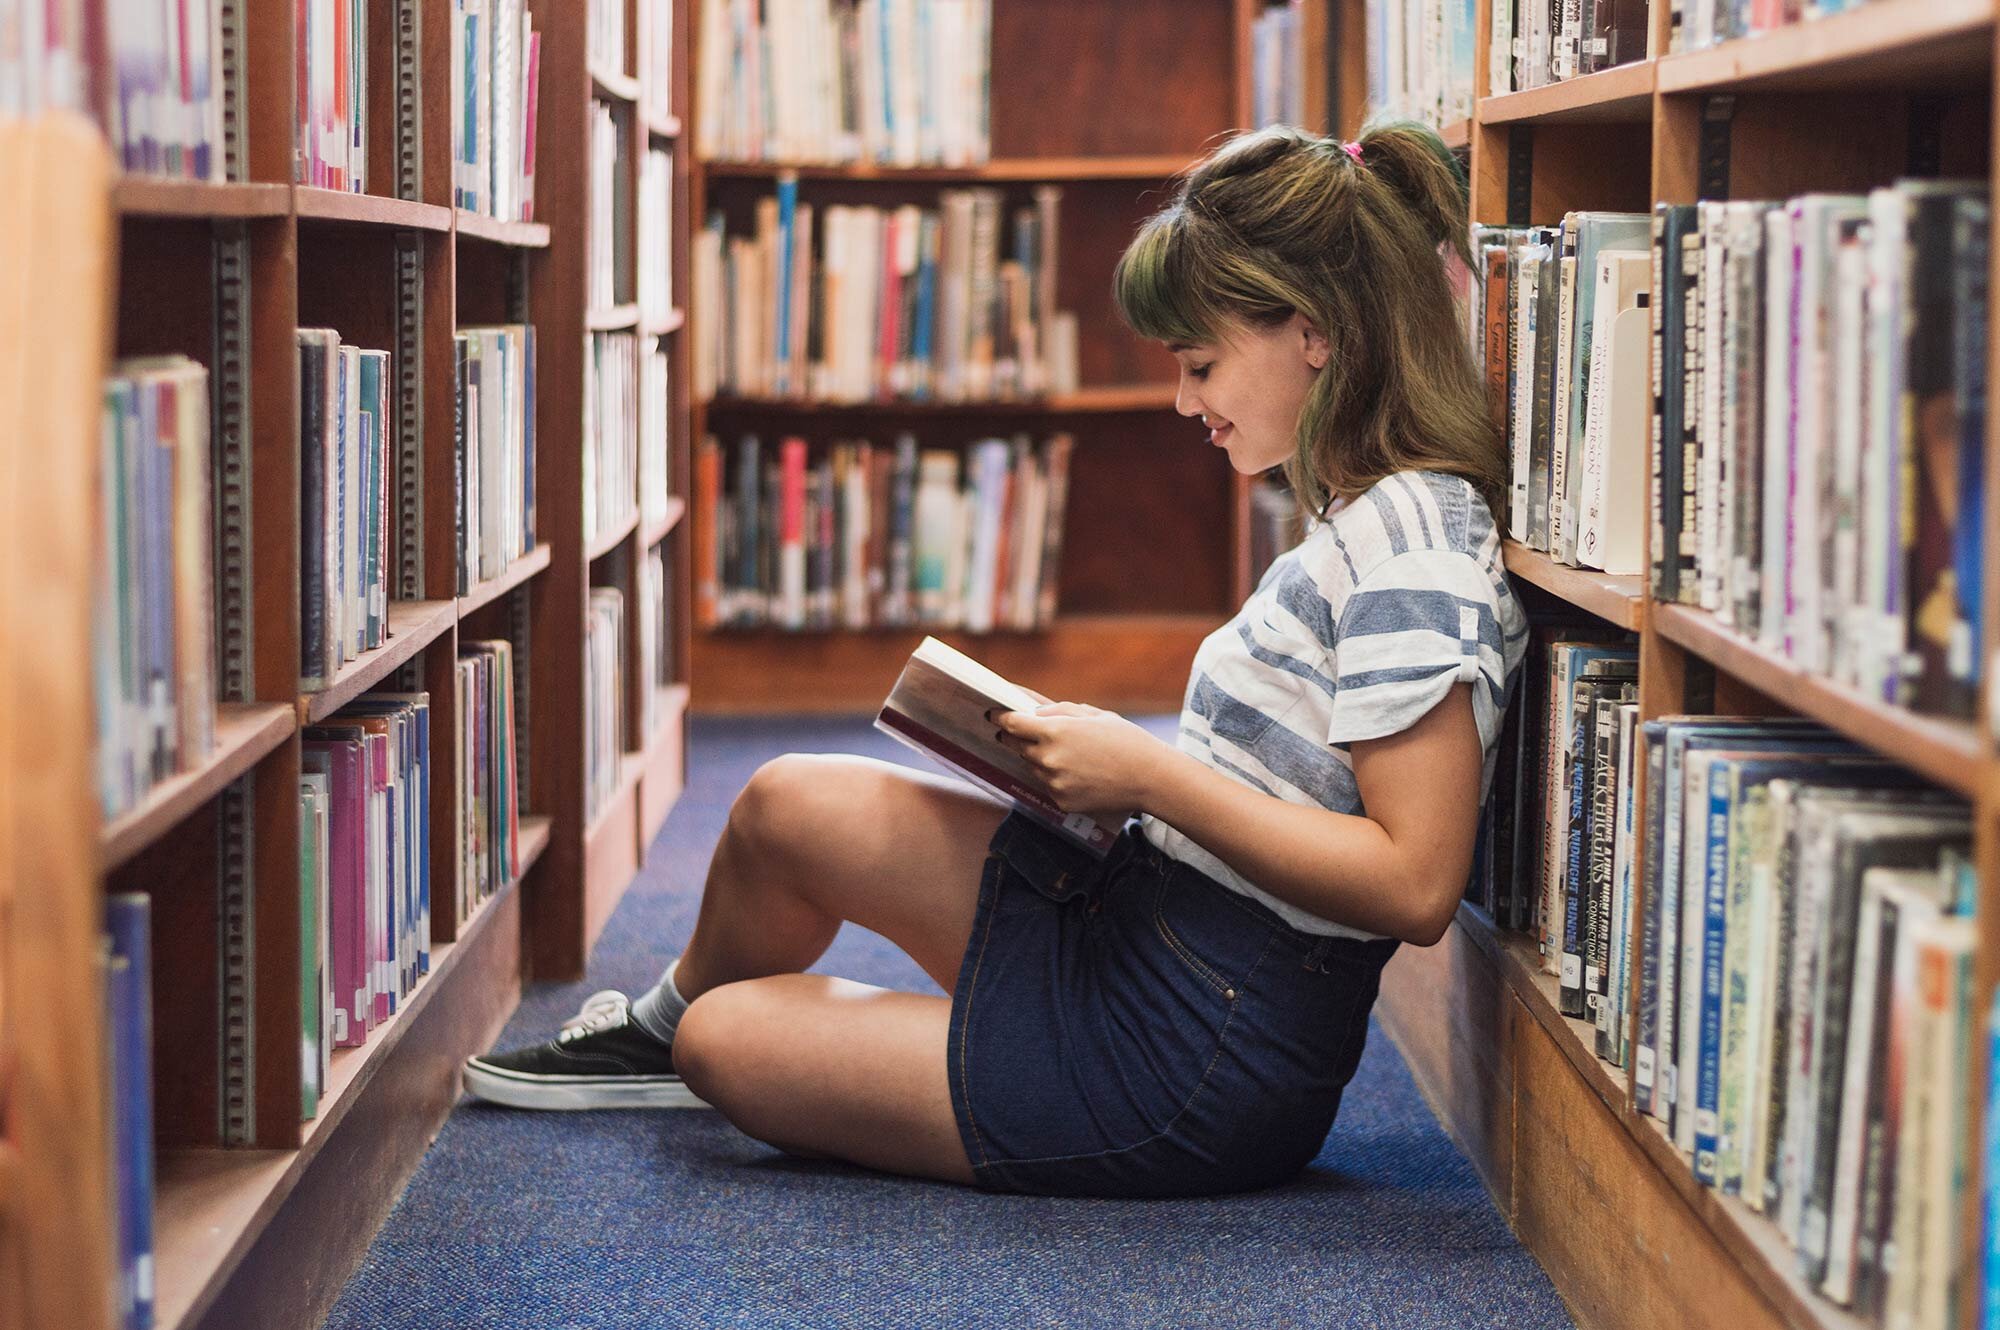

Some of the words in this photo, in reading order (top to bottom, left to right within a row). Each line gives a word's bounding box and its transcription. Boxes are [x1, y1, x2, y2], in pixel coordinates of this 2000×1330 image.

[1560, 293, 1569, 352] NADINE
[1593, 346, 1603, 392] DAVID
[1557, 356, 1566, 436] GORDIMER
[1587, 395, 1600, 475] GUTERSON
[1553, 490, 1562, 541] PPLE
[1574, 720, 1586, 759] JACK
[1572, 762, 1585, 819] HIGGINS
[1596, 749, 1609, 796] JACK
[1607, 765, 1616, 792] JACK
[1591, 802, 1608, 884] HIGGINS
[1605, 795, 1615, 843] HIGGINS
[1567, 828, 1582, 894] MIDNIGHT
[1602, 857, 1611, 883] FINE
[1565, 896, 1579, 953] RUNNER
[1601, 882, 1611, 918] NIGHT
[1588, 899, 1598, 959] CONNECTION
[1600, 918, 1609, 942] FOR
[1598, 942, 1608, 976] DYING
